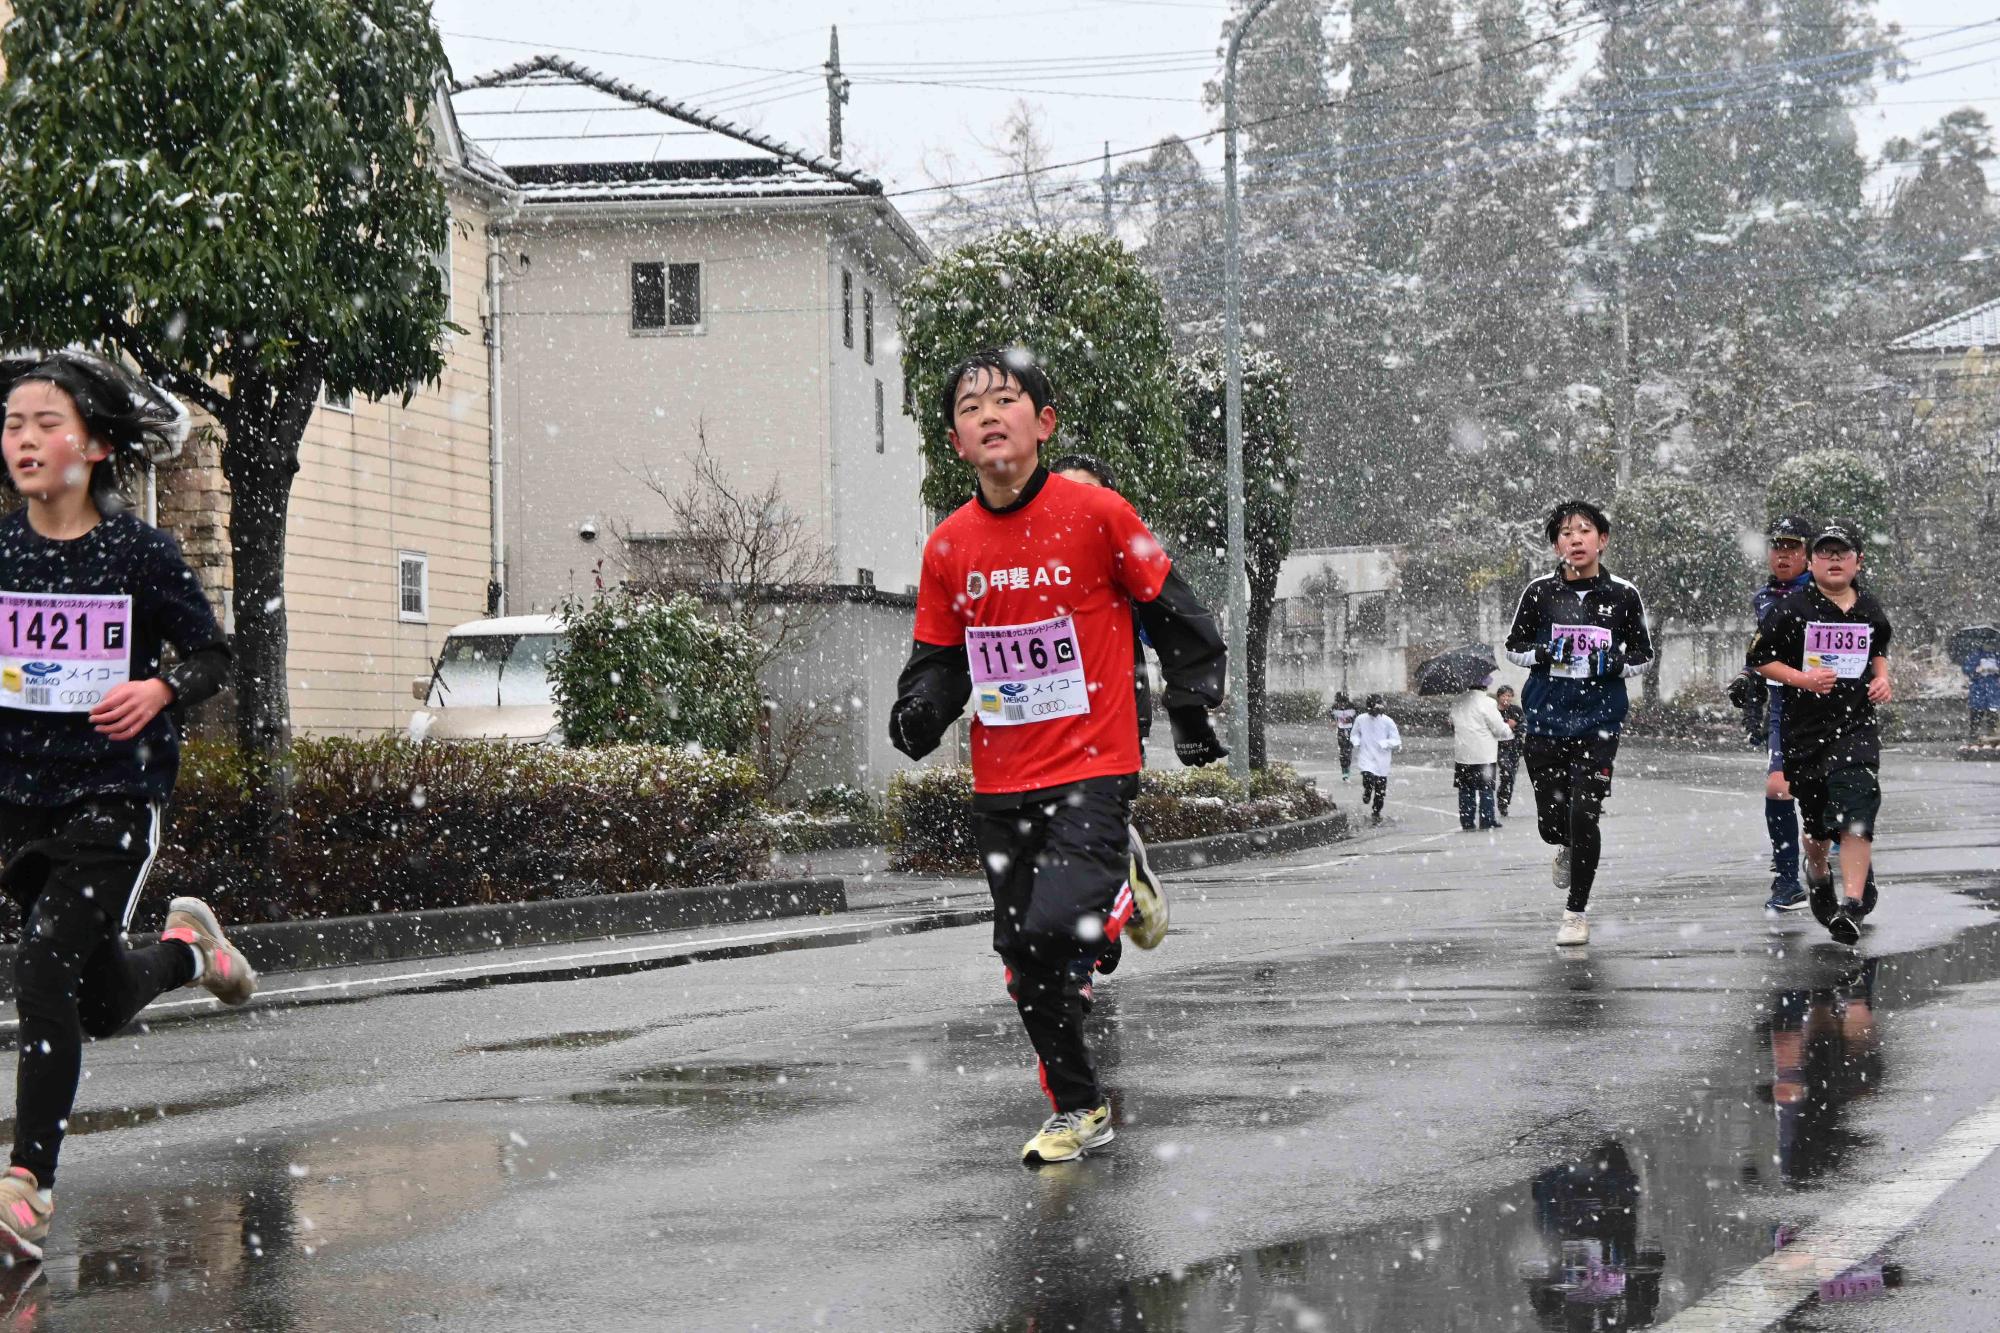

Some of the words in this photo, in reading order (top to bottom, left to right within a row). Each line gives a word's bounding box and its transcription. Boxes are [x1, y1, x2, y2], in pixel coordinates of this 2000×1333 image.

[9, 610, 88, 650] 1421
[107, 626, 121, 646] F
[1814, 631, 1854, 649] 1133
[1858, 637, 1867, 648] C
[979, 637, 1048, 674] 1116
[65, 667, 125, 681] メイコー
[1033, 678, 1082, 696] メイコー
[1003, 695, 1029, 704] MEIKO
